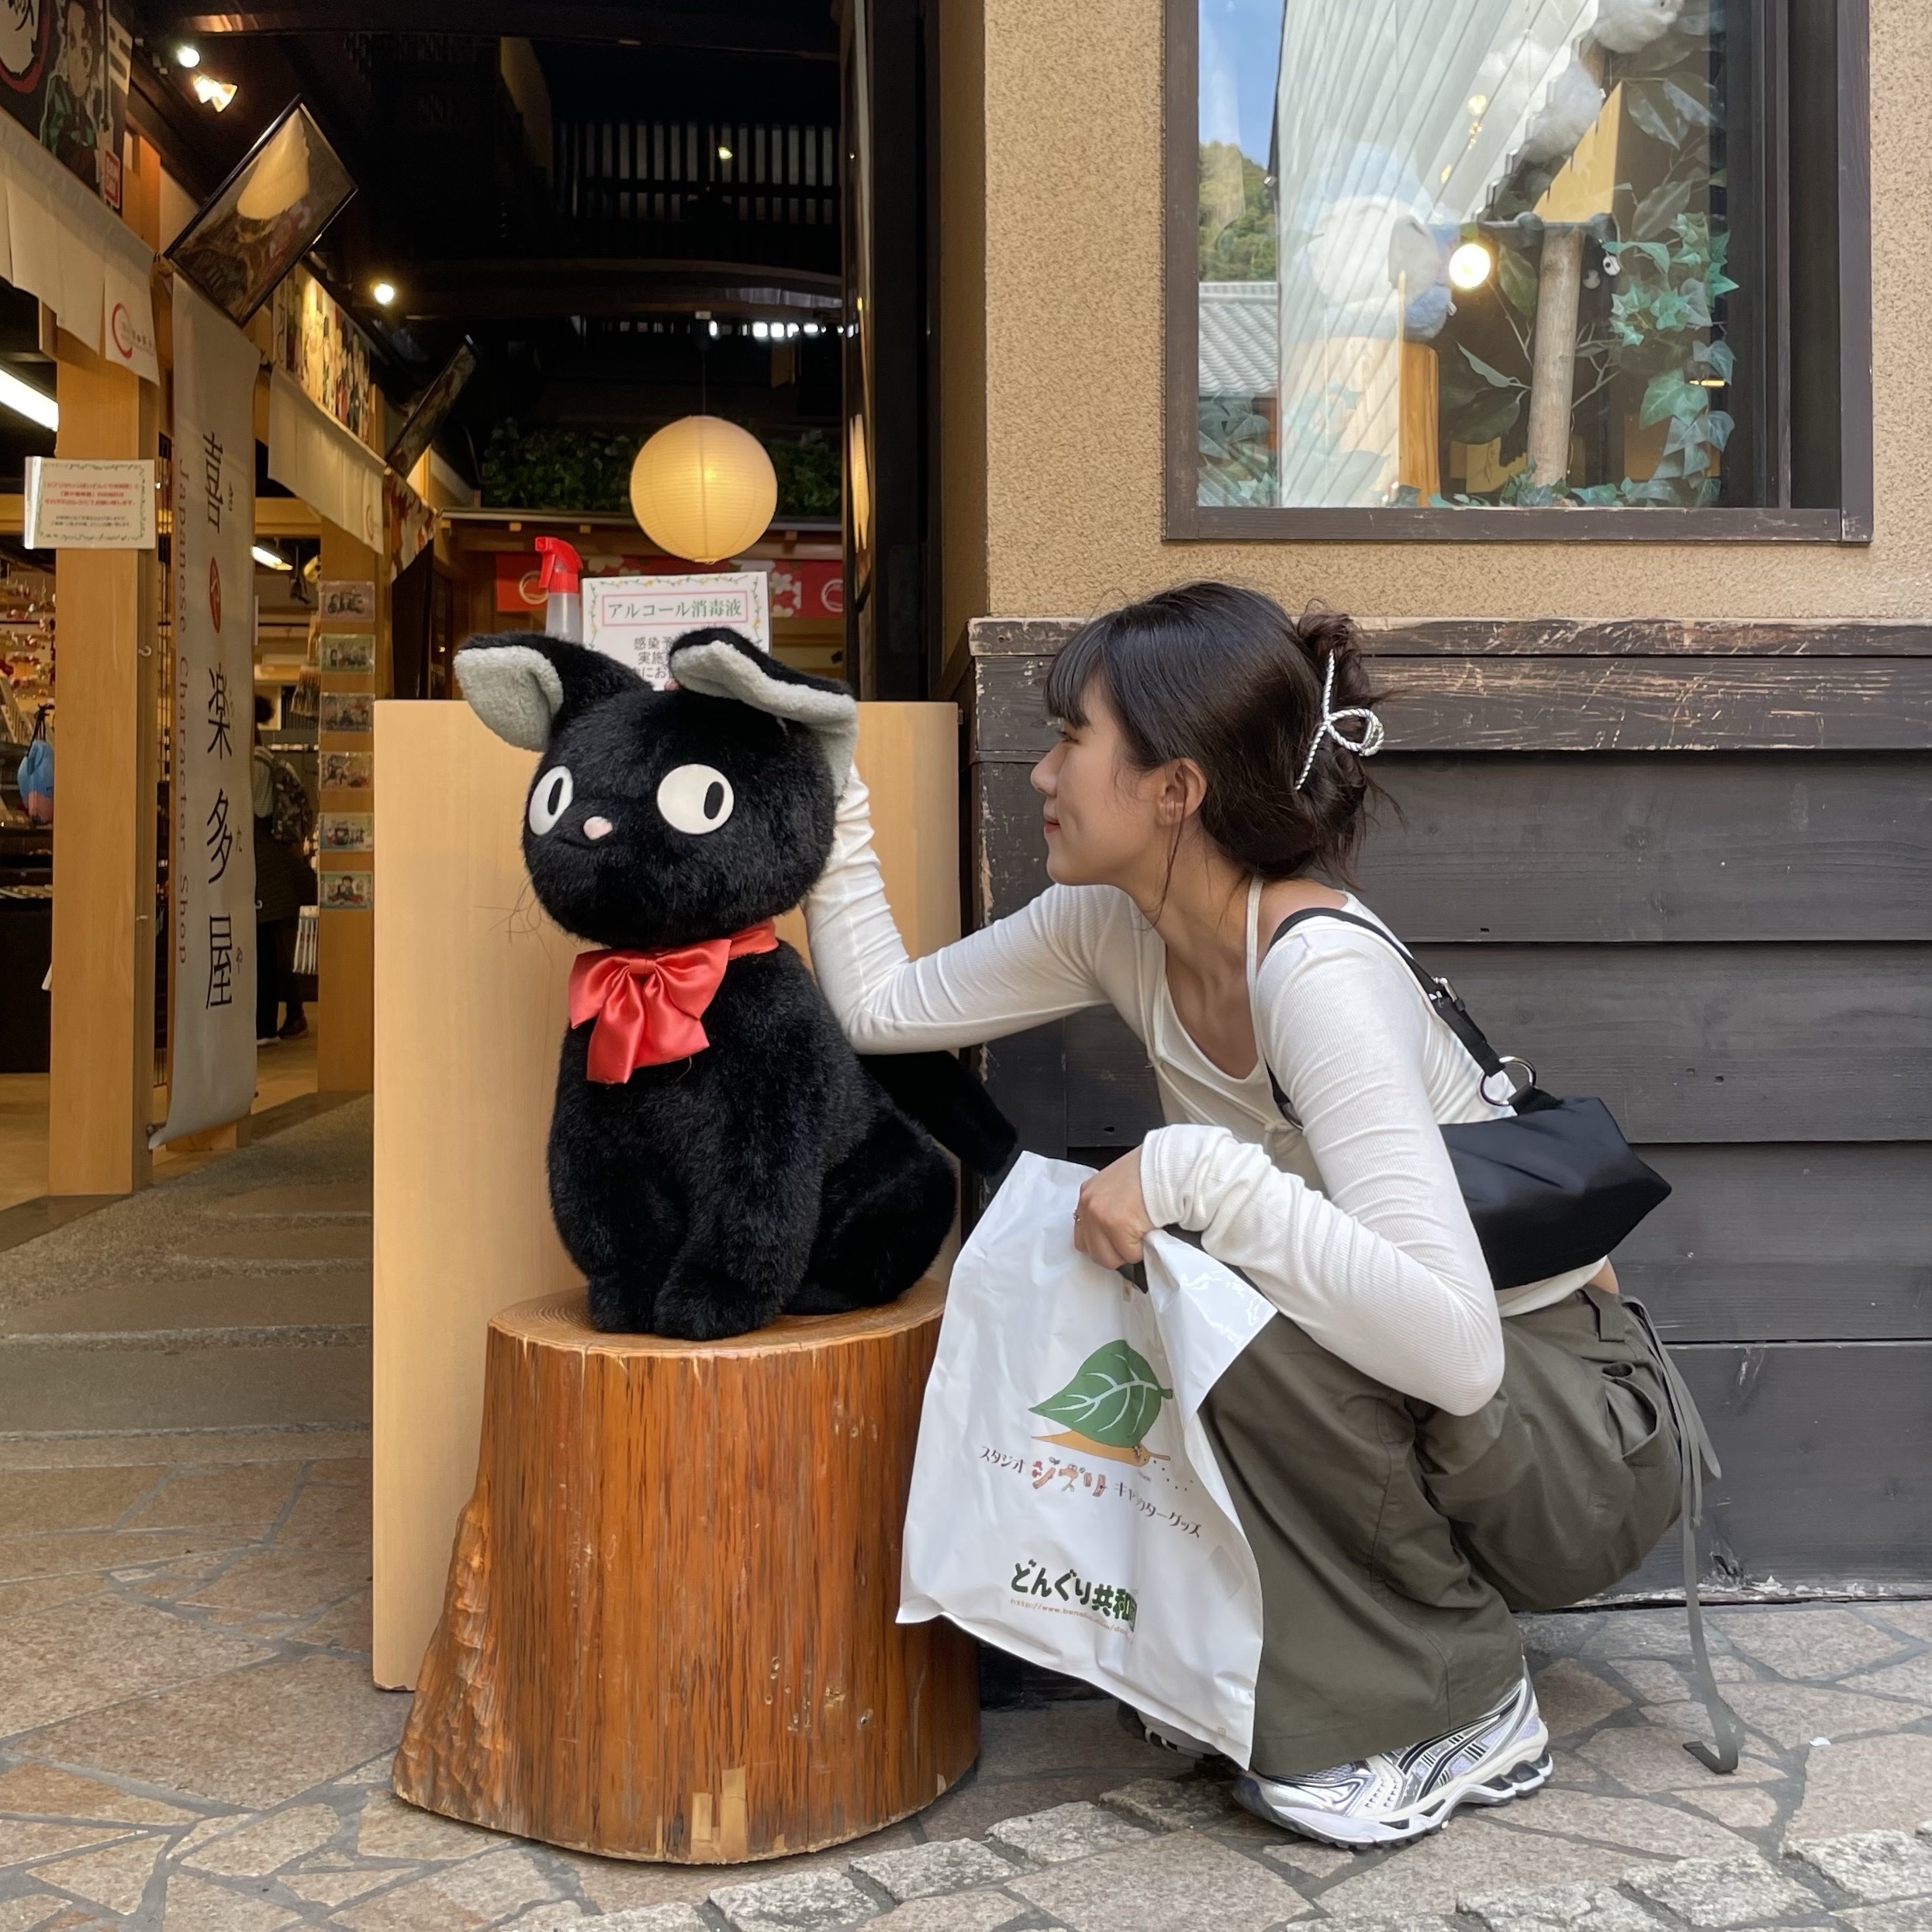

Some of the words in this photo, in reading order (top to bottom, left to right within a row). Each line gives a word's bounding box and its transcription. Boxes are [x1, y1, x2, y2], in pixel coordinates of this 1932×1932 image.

[178, 457, 191, 634] Japanese
[607, 598, 742, 619] アルコール消毒液
[634, 636, 673, 650] 感染予
[638, 651, 671, 665] 実施
[178, 656, 189, 852] Character
[178, 874, 189, 965] Shop
[979, 1446, 1026, 1474] スタジオ
[1032, 1456, 1108, 1498] ジブリ
[1115, 1481, 1201, 1539] キャクターグッズ
[1011, 1558, 1137, 1633] どんぐり共和
